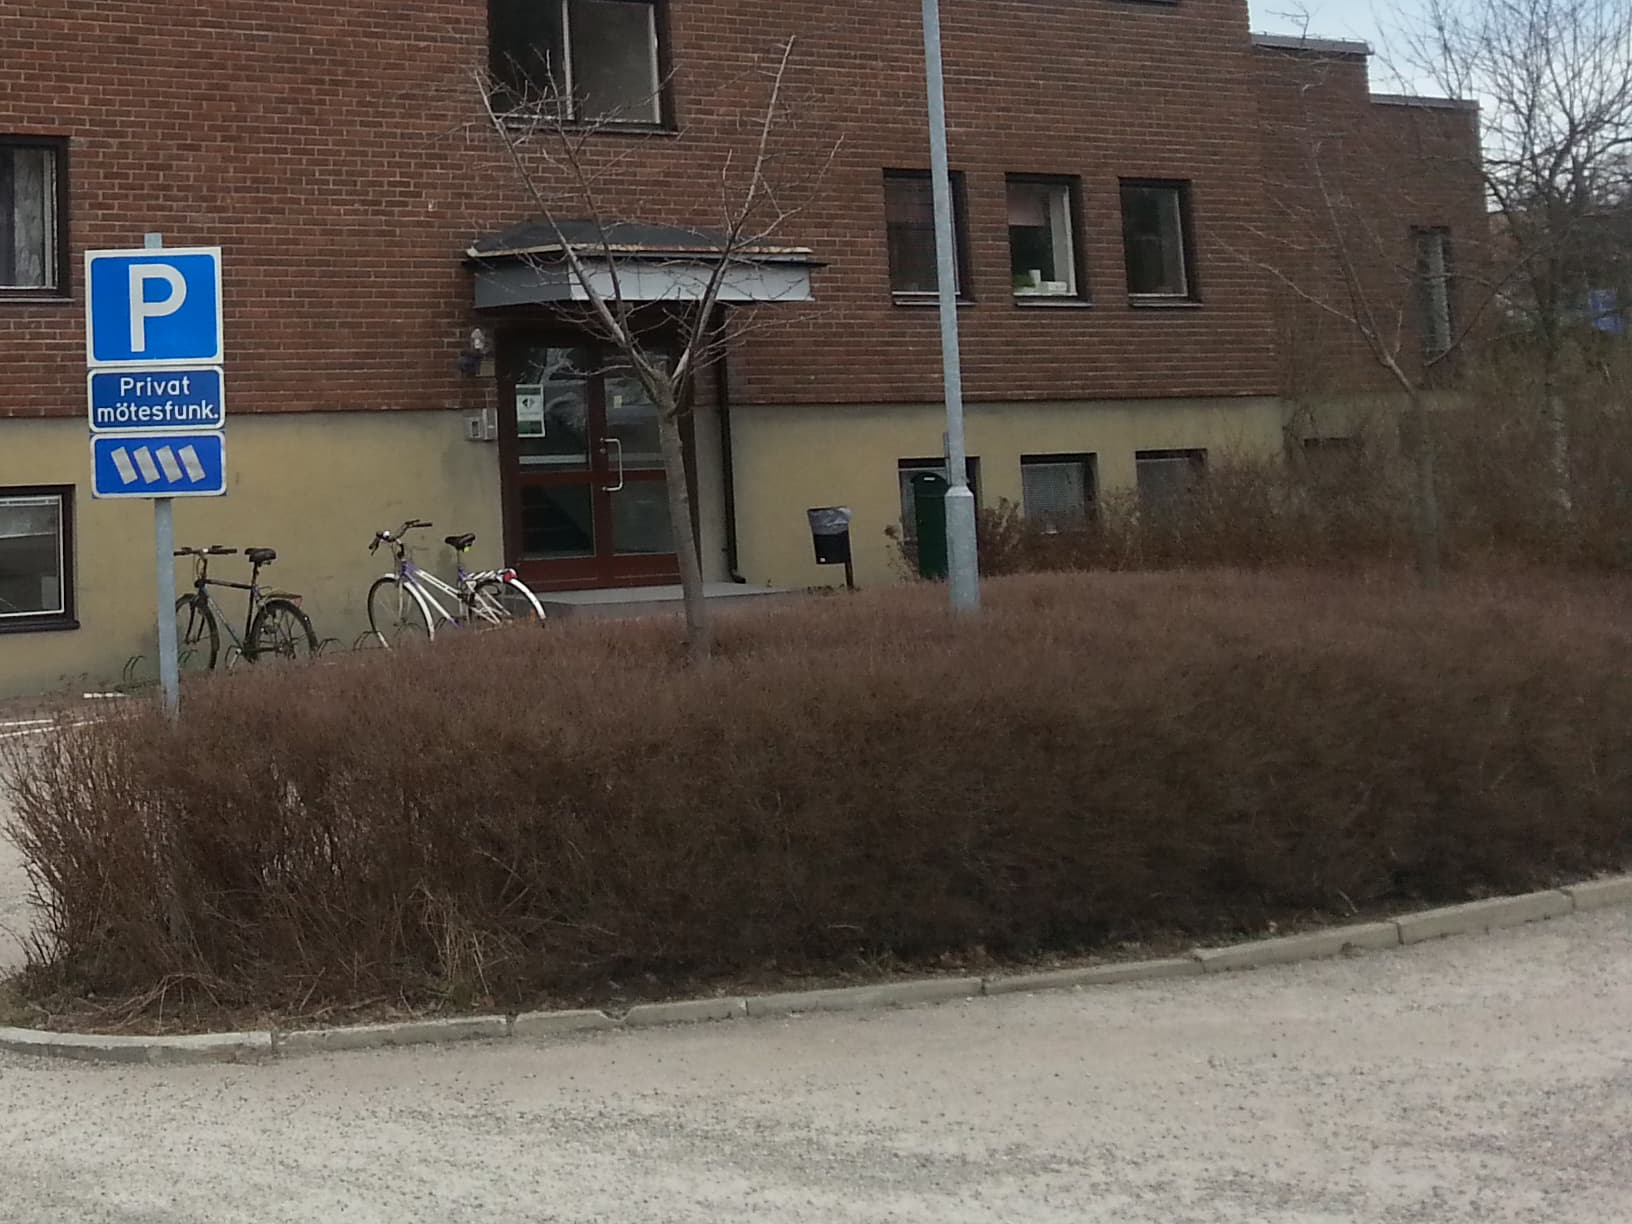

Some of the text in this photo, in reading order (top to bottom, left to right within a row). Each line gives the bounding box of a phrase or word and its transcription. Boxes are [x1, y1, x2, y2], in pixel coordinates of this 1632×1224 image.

[128, 263, 187, 353] P
[120, 376, 190, 396] Privat
[97, 400, 219, 422] mötesfunk.
